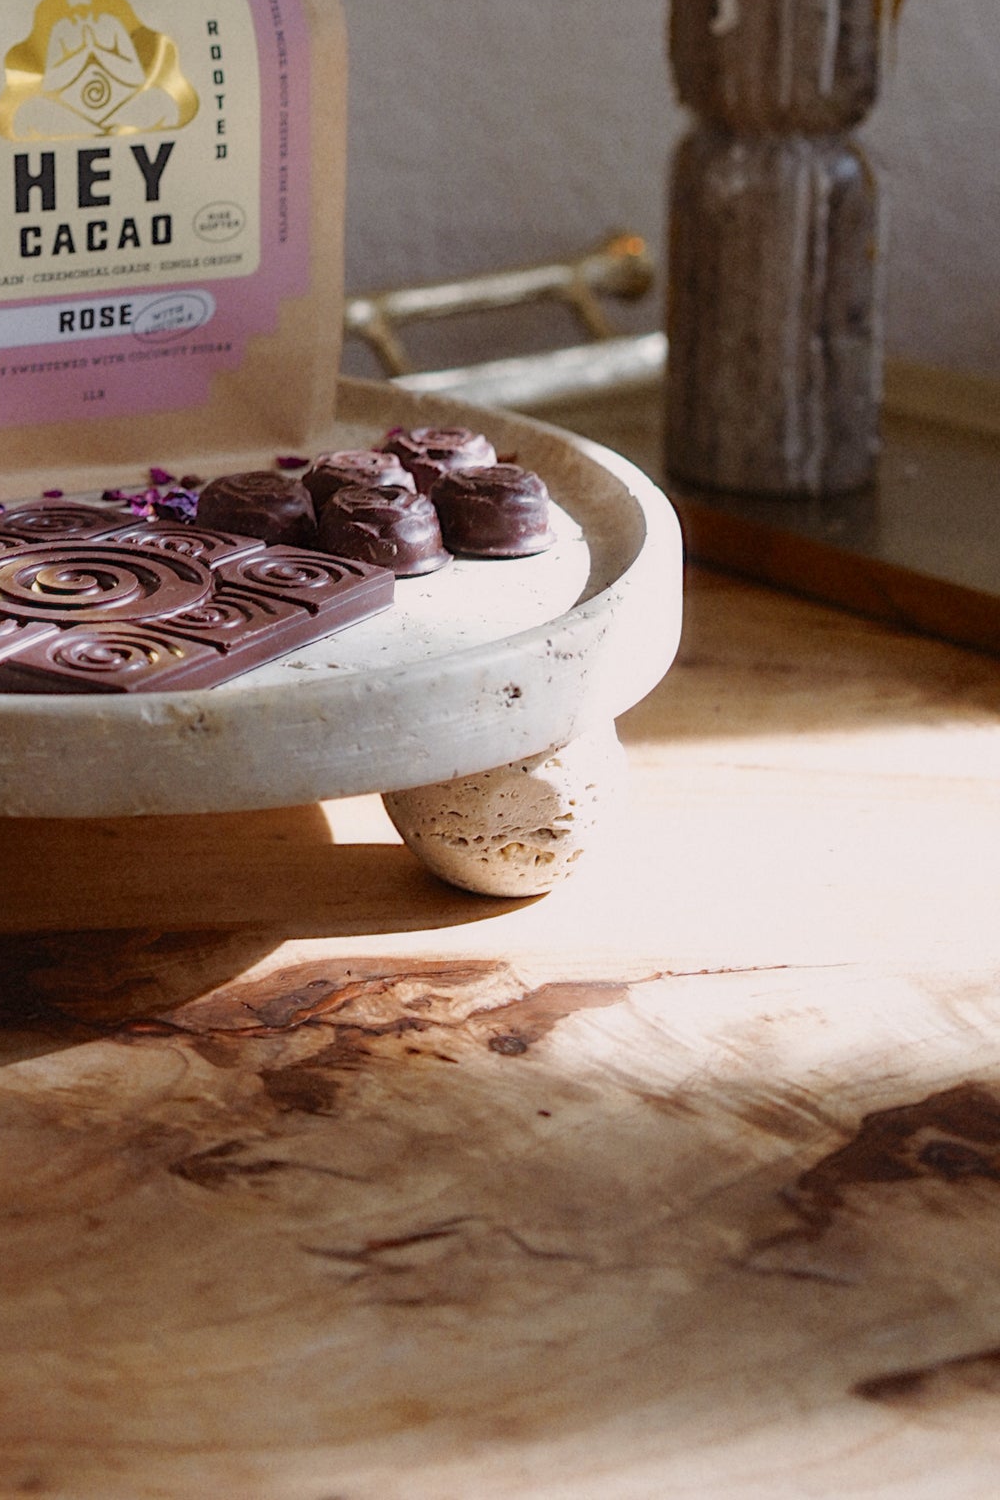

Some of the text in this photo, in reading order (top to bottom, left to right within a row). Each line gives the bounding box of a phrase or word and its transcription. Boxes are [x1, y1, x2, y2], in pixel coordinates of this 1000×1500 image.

[206, 20, 228, 161] ROOTED
[14, 142, 175, 213] HEY
[20, 214, 173, 258] CACAO
[32, 267, 111, 284] CEREMONIAL
[111, 262, 151, 276] GRADE
[58, 303, 133, 334] ROSE
